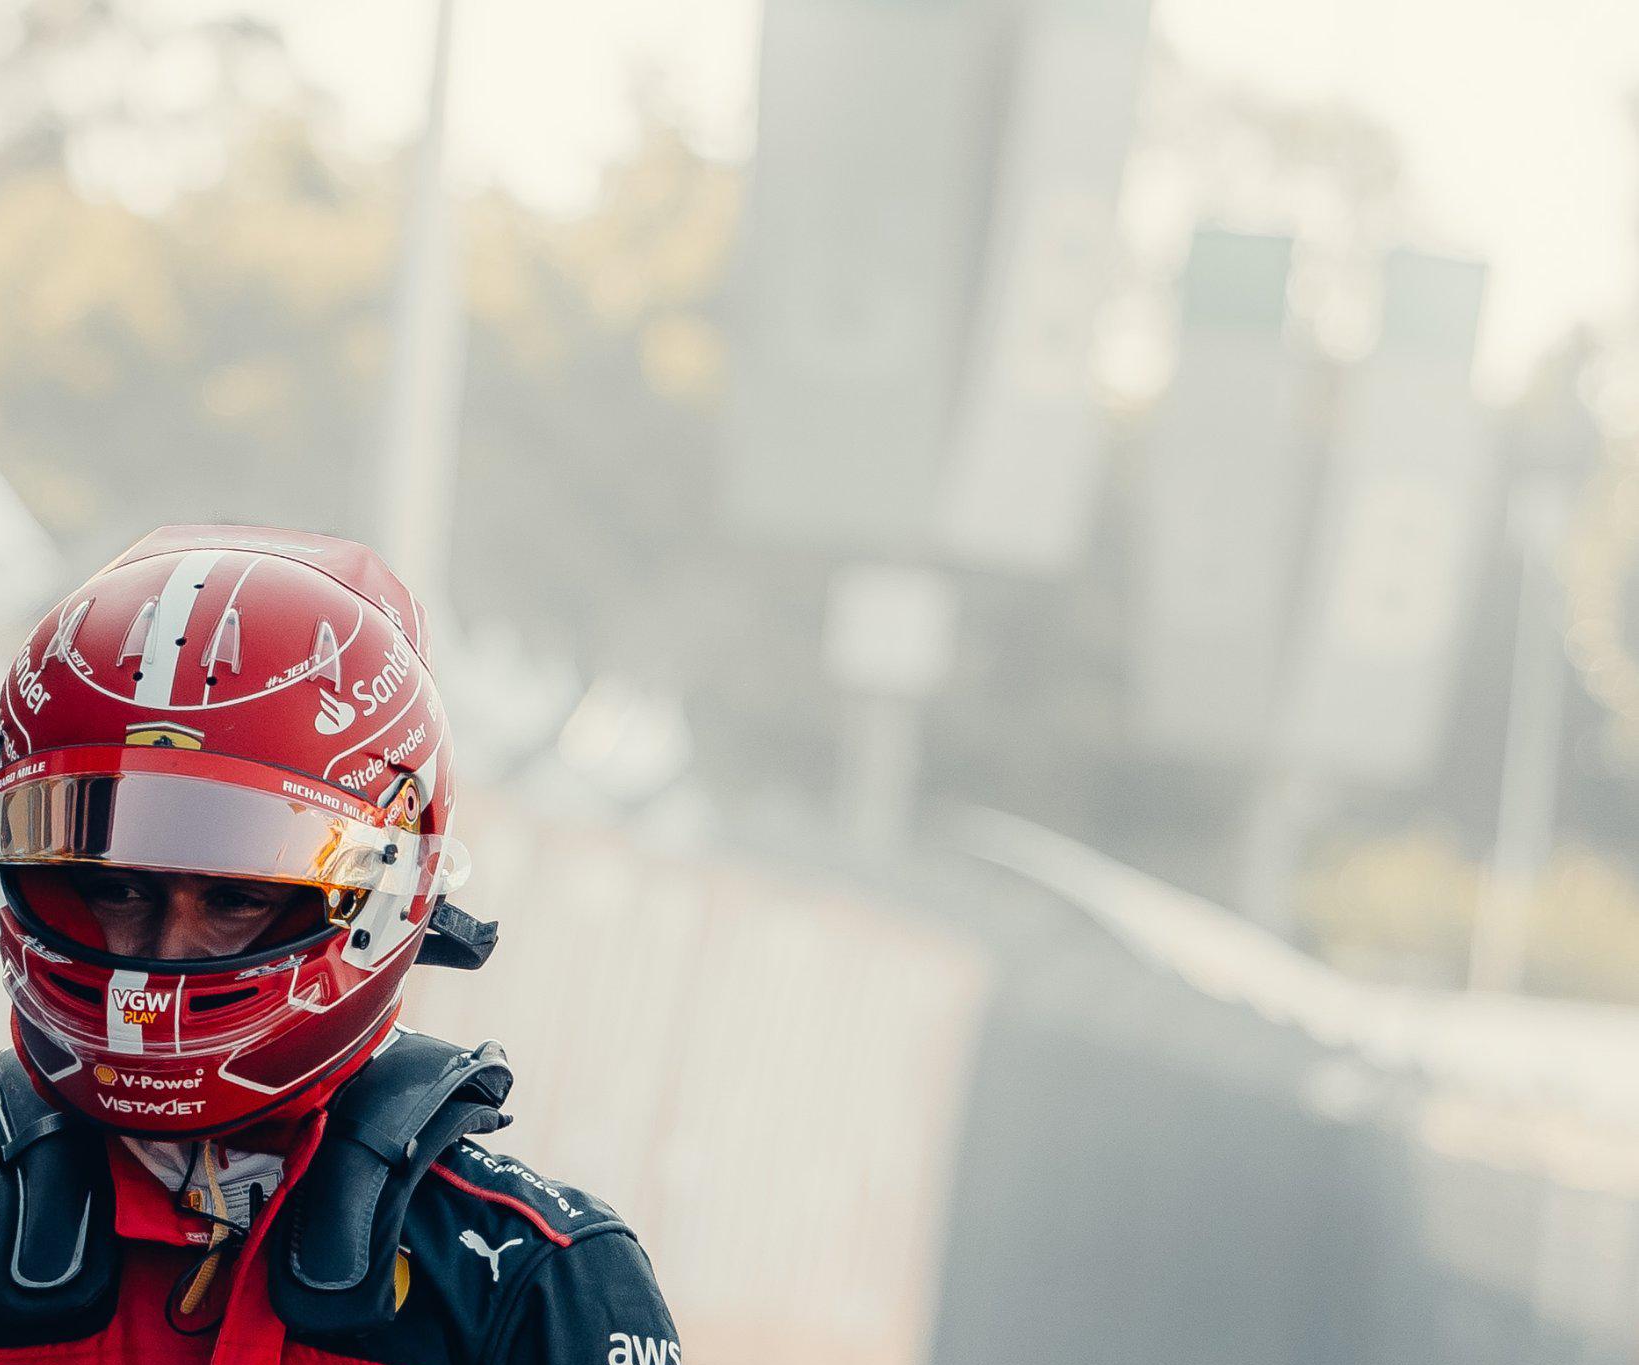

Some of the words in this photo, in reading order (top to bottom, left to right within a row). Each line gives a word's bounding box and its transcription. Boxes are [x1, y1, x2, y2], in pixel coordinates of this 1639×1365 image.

[282, 779, 340, 811] RICHARD
[341, 801, 375, 825] MILLE
[113, 988, 172, 1013] VGW
[124, 1010, 158, 1024] PLAY
[121, 1072, 203, 1091] V-Power
[461, 1144, 585, 1219] TECHNOLOGY
